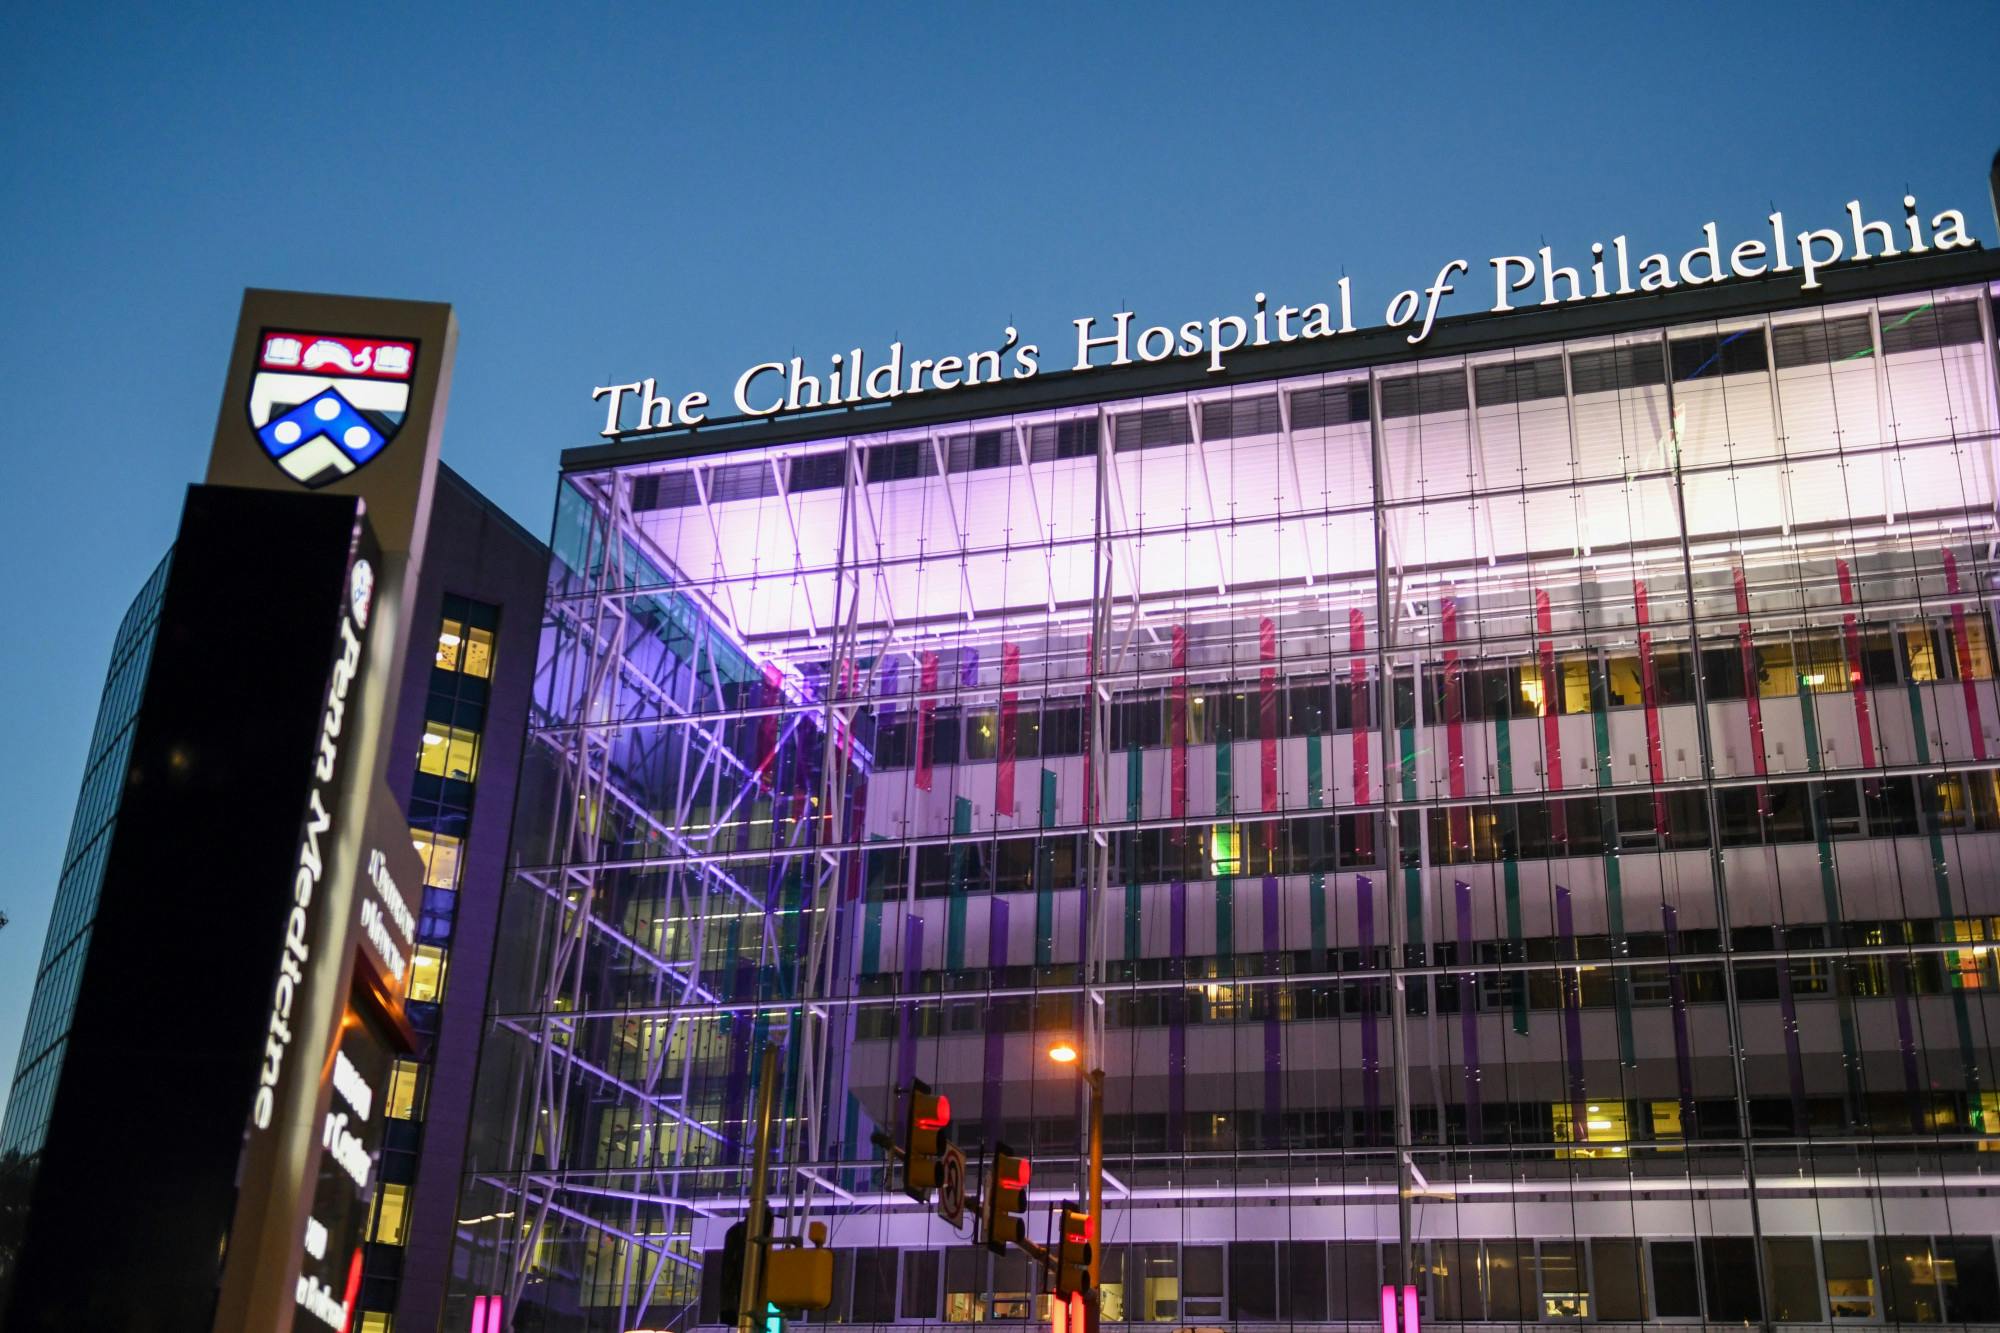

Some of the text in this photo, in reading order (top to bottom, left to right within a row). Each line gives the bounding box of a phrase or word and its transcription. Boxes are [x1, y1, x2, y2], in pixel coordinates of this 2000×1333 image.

[592, 195, 1976, 435] The Children's Hospital of Philadelphia
[254, 616, 361, 1130] Penn Medicine
